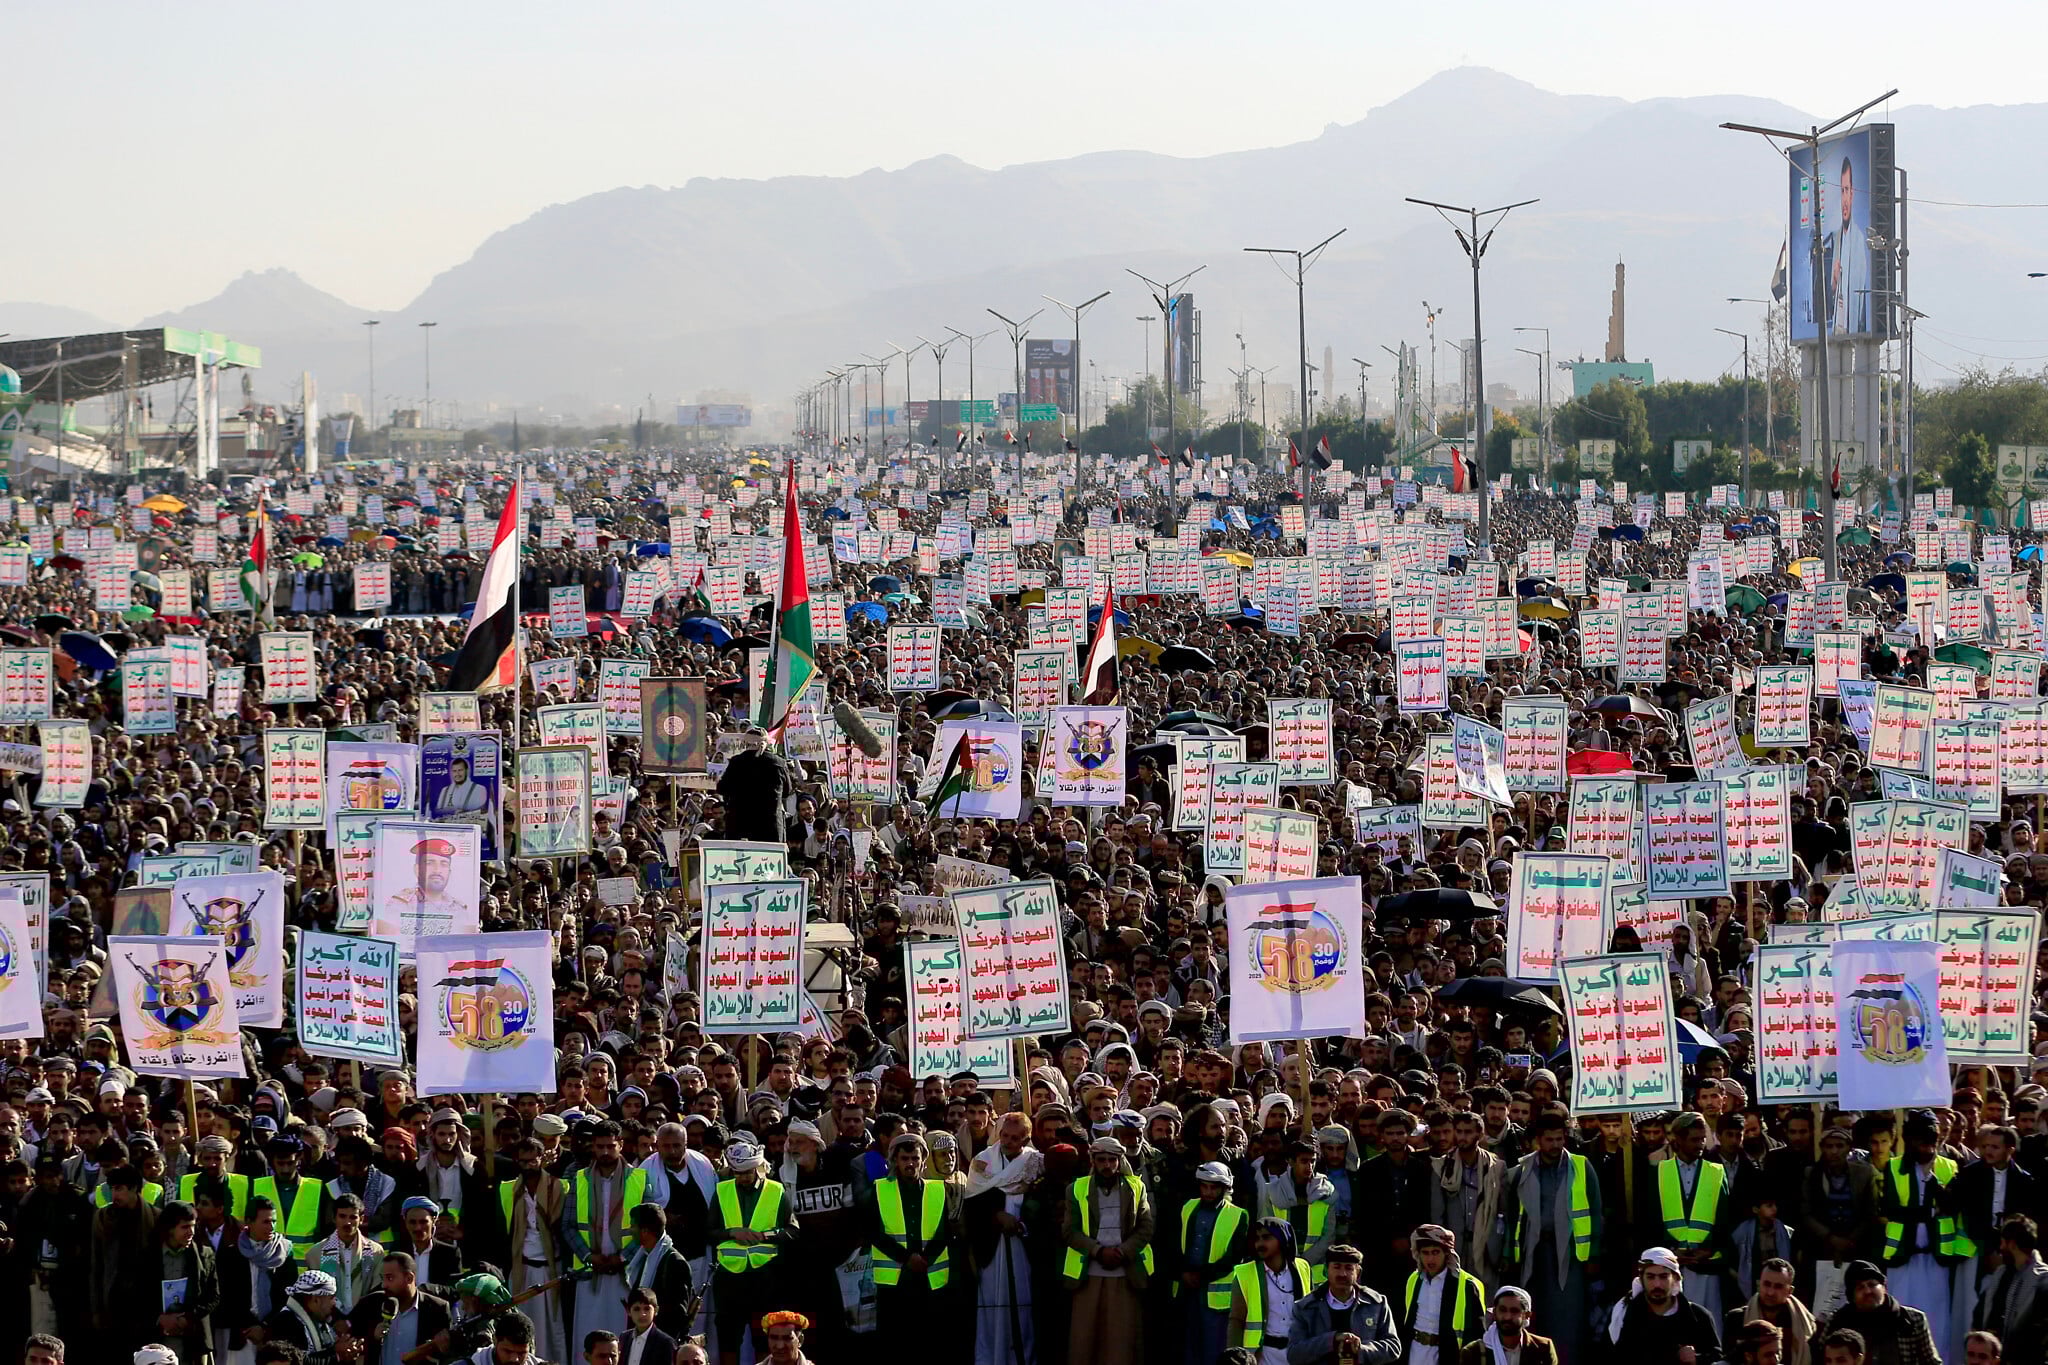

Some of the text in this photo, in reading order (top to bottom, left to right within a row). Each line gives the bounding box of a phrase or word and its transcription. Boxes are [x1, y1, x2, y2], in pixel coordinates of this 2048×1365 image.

[1650, 784, 1717, 810] الله أكبر
[1362, 808, 1416, 831] الله أكبر
[1651, 809, 1716, 826] الموت لأمريكا
[1652, 831, 1718, 846] الموت لإسرائيل
[709, 854, 751, 881] أكبر
[1653, 849, 1719, 864] اللعنة على اليهود
[1654, 865, 1721, 888] النصر للإسلام
[713, 886, 798, 919] الله أكبر
[963, 889, 1050, 929] الله أكبر
[712, 919, 796, 940] الموت لأمريكا
[966, 926, 1053, 949] الموت لأمريكا
[1940, 916, 2029, 946] الله أكبر
[306, 940, 389, 968] الله أكبر
[710, 946, 794, 966] الموت لإسرائيل
[971, 952, 1056, 977] الموت لإسرائيل
[1262, 935, 1315, 984] 58
[1989, 952, 2025, 968] الموت
[306, 966, 388, 989] الموت لأمريكا
[1573, 960, 1660, 997] الله أكبر
[1763, 949, 1816, 985] أكبر
[709, 970, 794, 990] اللعنة على اليهود
[972, 979, 1060, 1003] اللعنة على اليهود
[1987, 976, 2022, 992] الموت
[306, 987, 388, 1010] الموت لإسرائيل
[710, 992, 794, 1021] النصر للإسلام
[1576, 994, 1662, 1018] الموت لأمريكا
[1764, 984, 1810, 1008] لأمريكا
[1970, 998, 2020, 1016] اللعنة على
[306, 1007, 389, 1027] اللعنة على اليهود
[450, 992, 505, 1041] 58
[972, 1002, 1062, 1032] النصر للإسلام
[1764, 1013, 1811, 1034] لإسرائيل
[306, 1023, 390, 1047] النصر للإسلام
[1578, 1022, 1664, 1046] الموت لإسرائيل
[1979, 1019, 2017, 1046] النصر
[1581, 1047, 1666, 1070] اللعنة على اليهود
[1764, 1041, 1797, 1060] اليهود
[1802, 1040, 1820, 1060] على
[1581, 1070, 1668, 1102] النصر للإسلام
[1767, 1064, 1811, 1092] للإسلام
